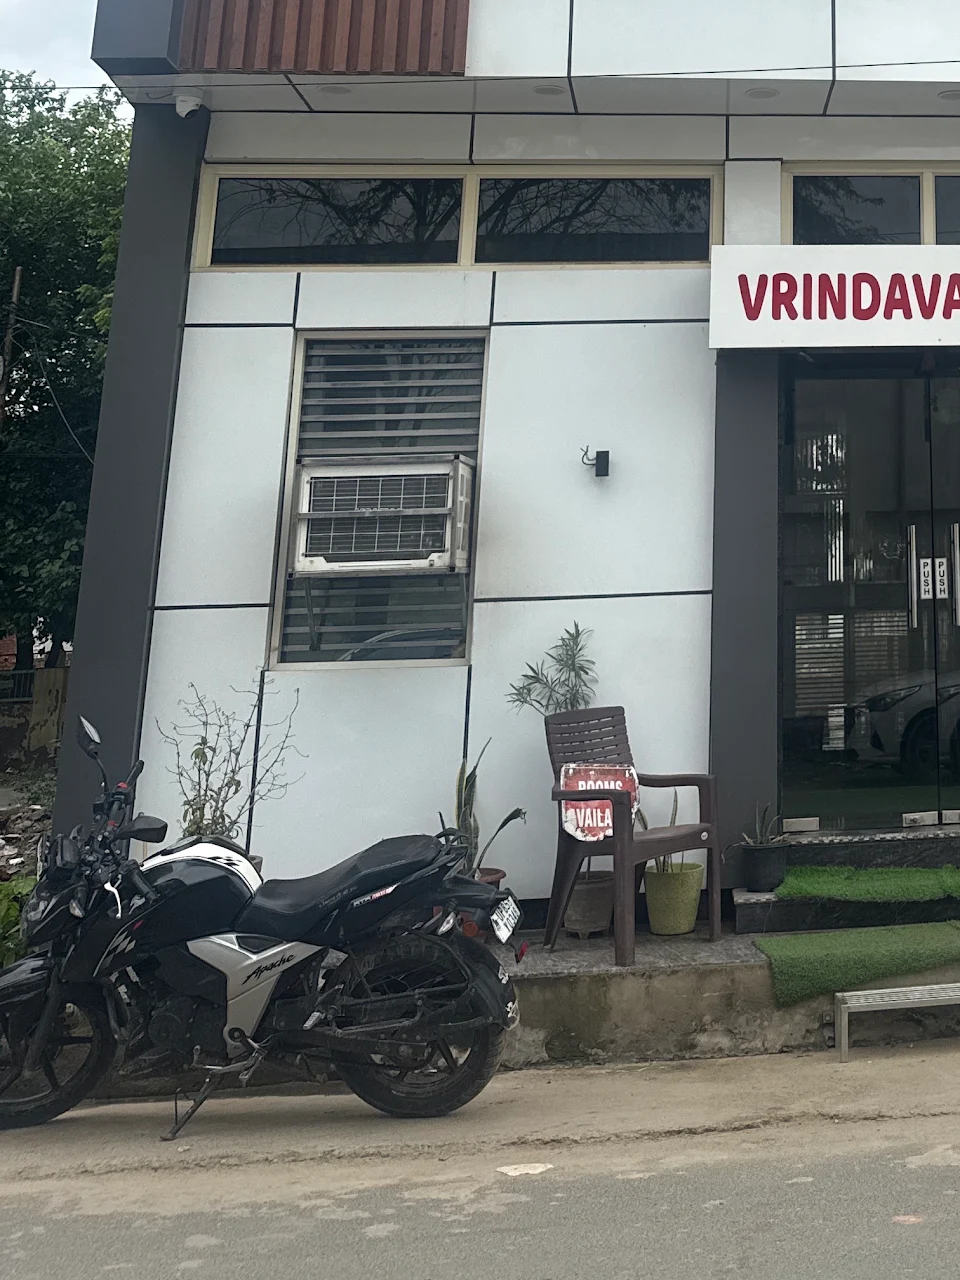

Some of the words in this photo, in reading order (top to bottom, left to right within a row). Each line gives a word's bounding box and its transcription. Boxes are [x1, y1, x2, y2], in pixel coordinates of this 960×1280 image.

[922, 561, 930, 596] PUSH
[938, 561, 946, 595] PUSH
[241, 954, 296, 985] Apache
